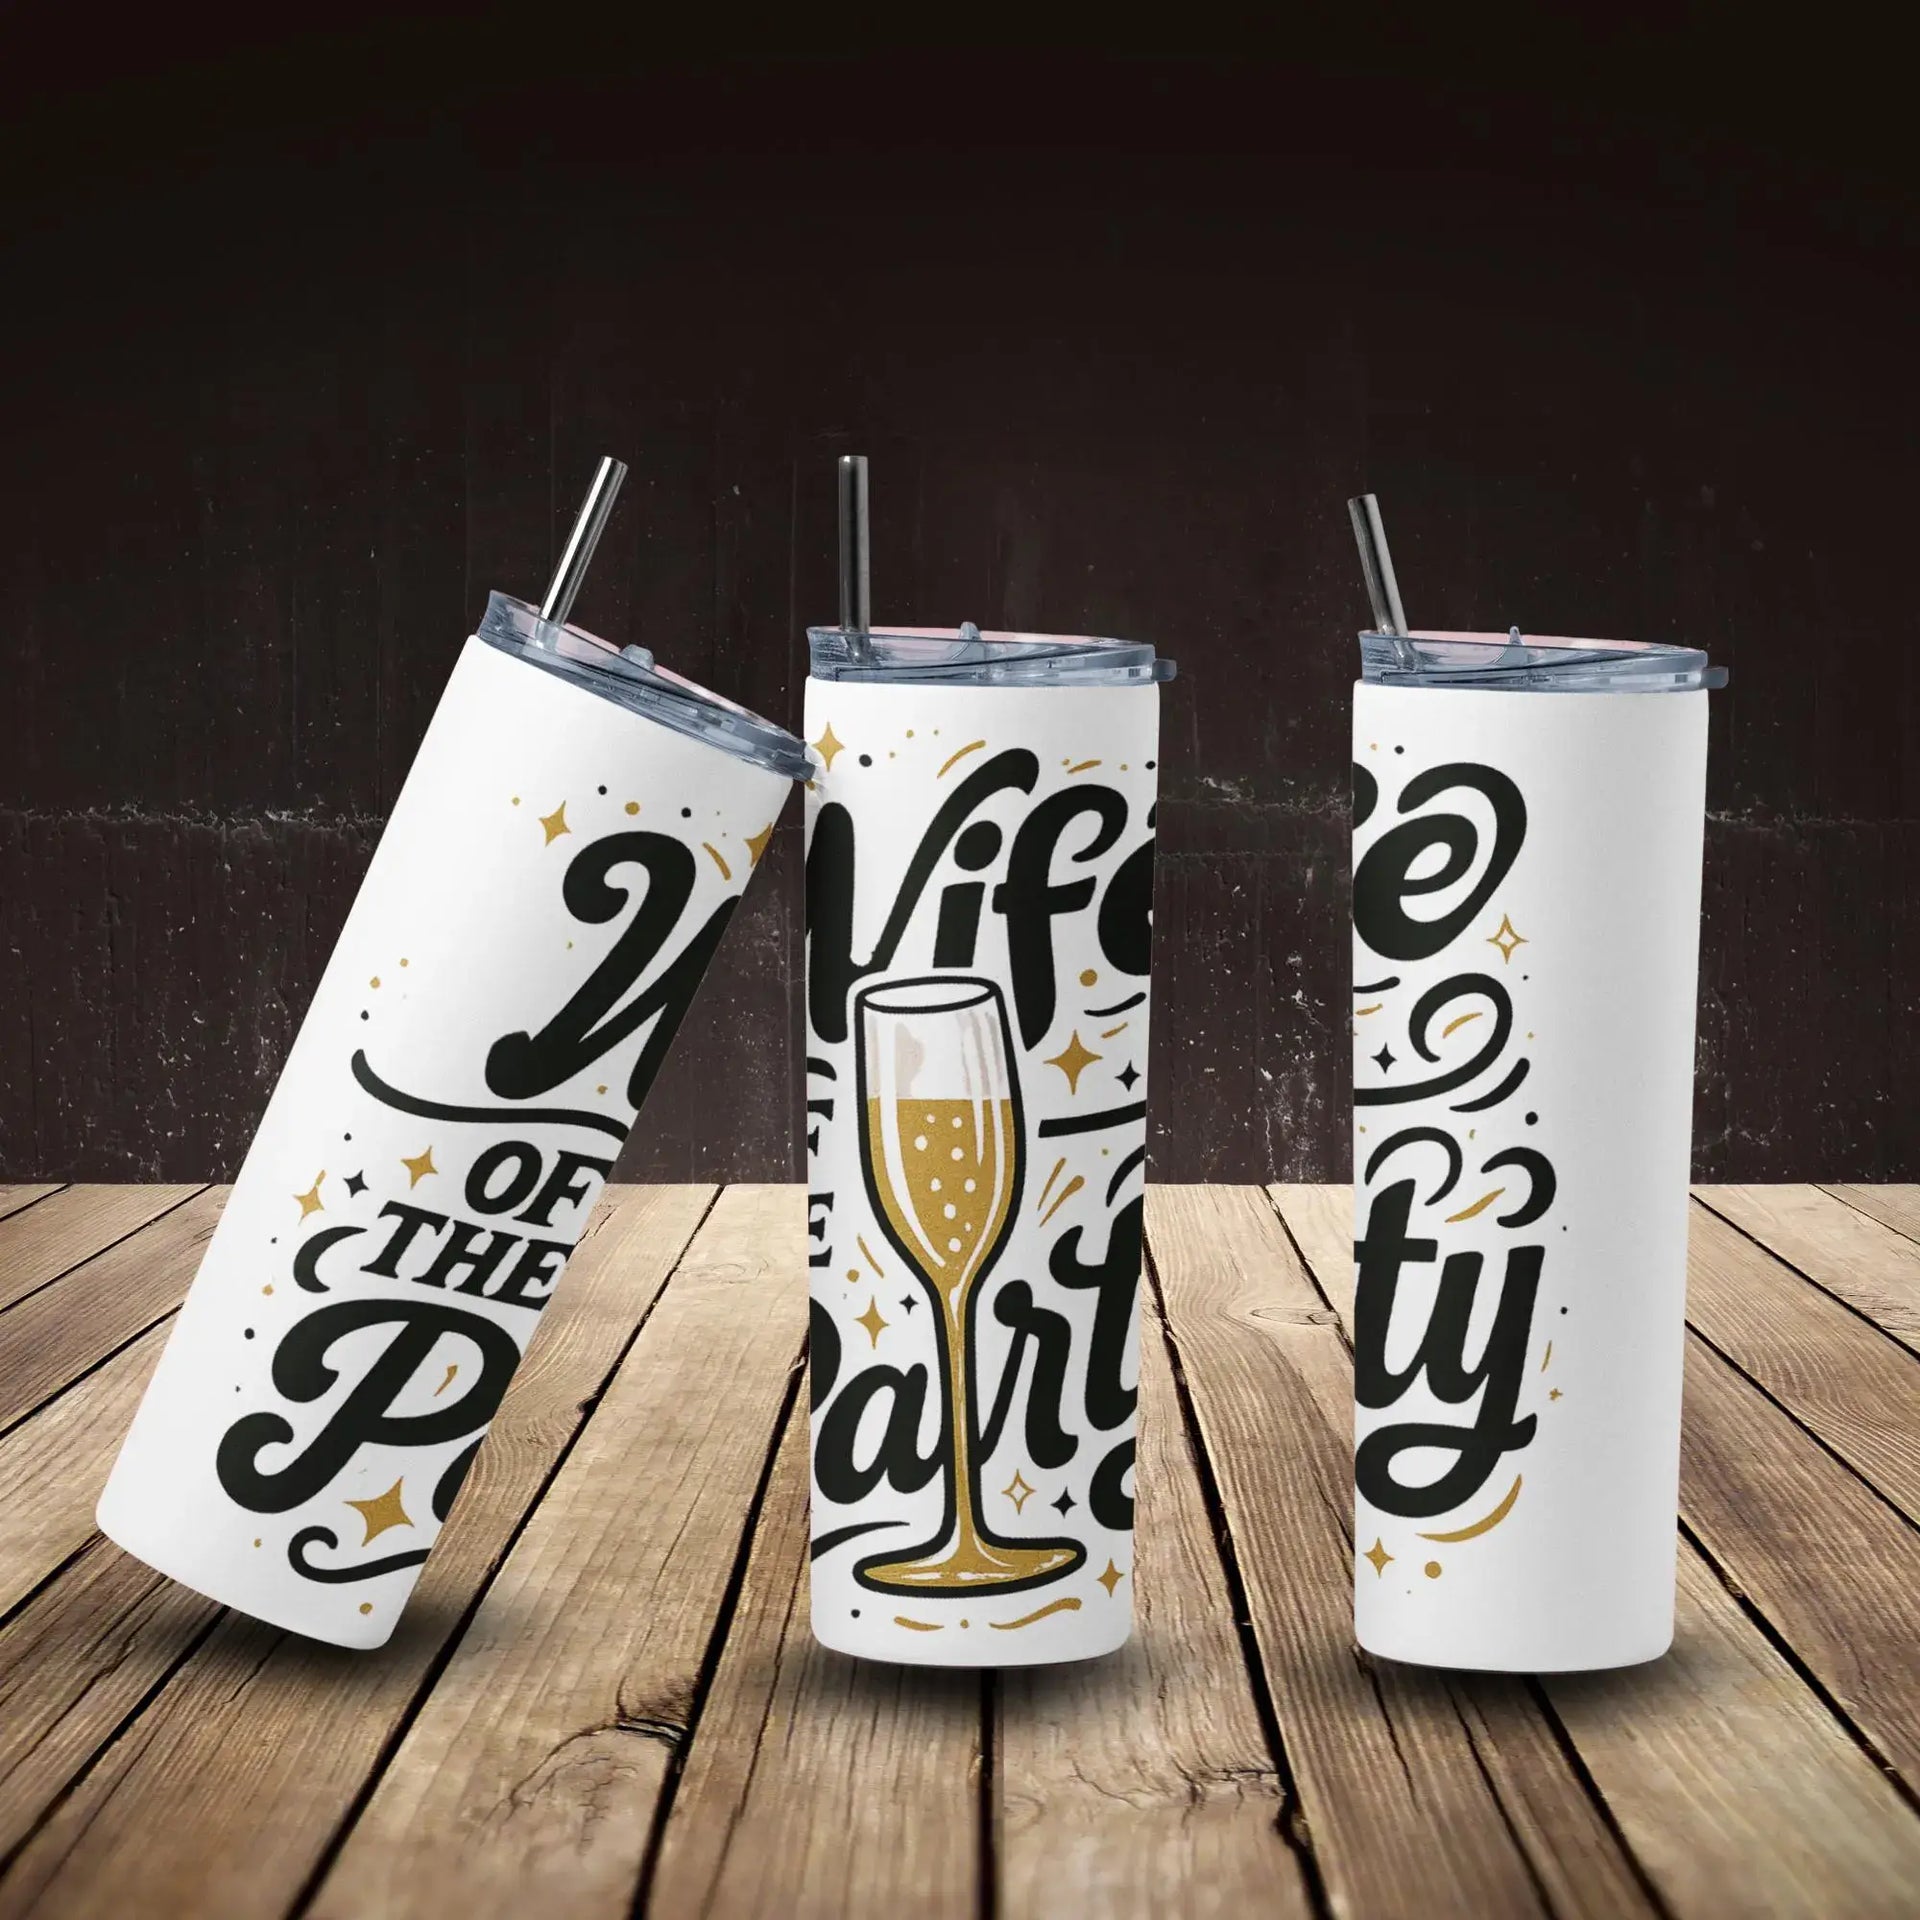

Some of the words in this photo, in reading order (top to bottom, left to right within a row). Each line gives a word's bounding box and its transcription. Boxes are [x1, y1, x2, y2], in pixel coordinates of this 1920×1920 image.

[1353, 762, 1528, 960] e
[359, 1200, 576, 1311] THE
[465, 1140, 615, 1227] OF
[217, 1299, 521, 1523] P
